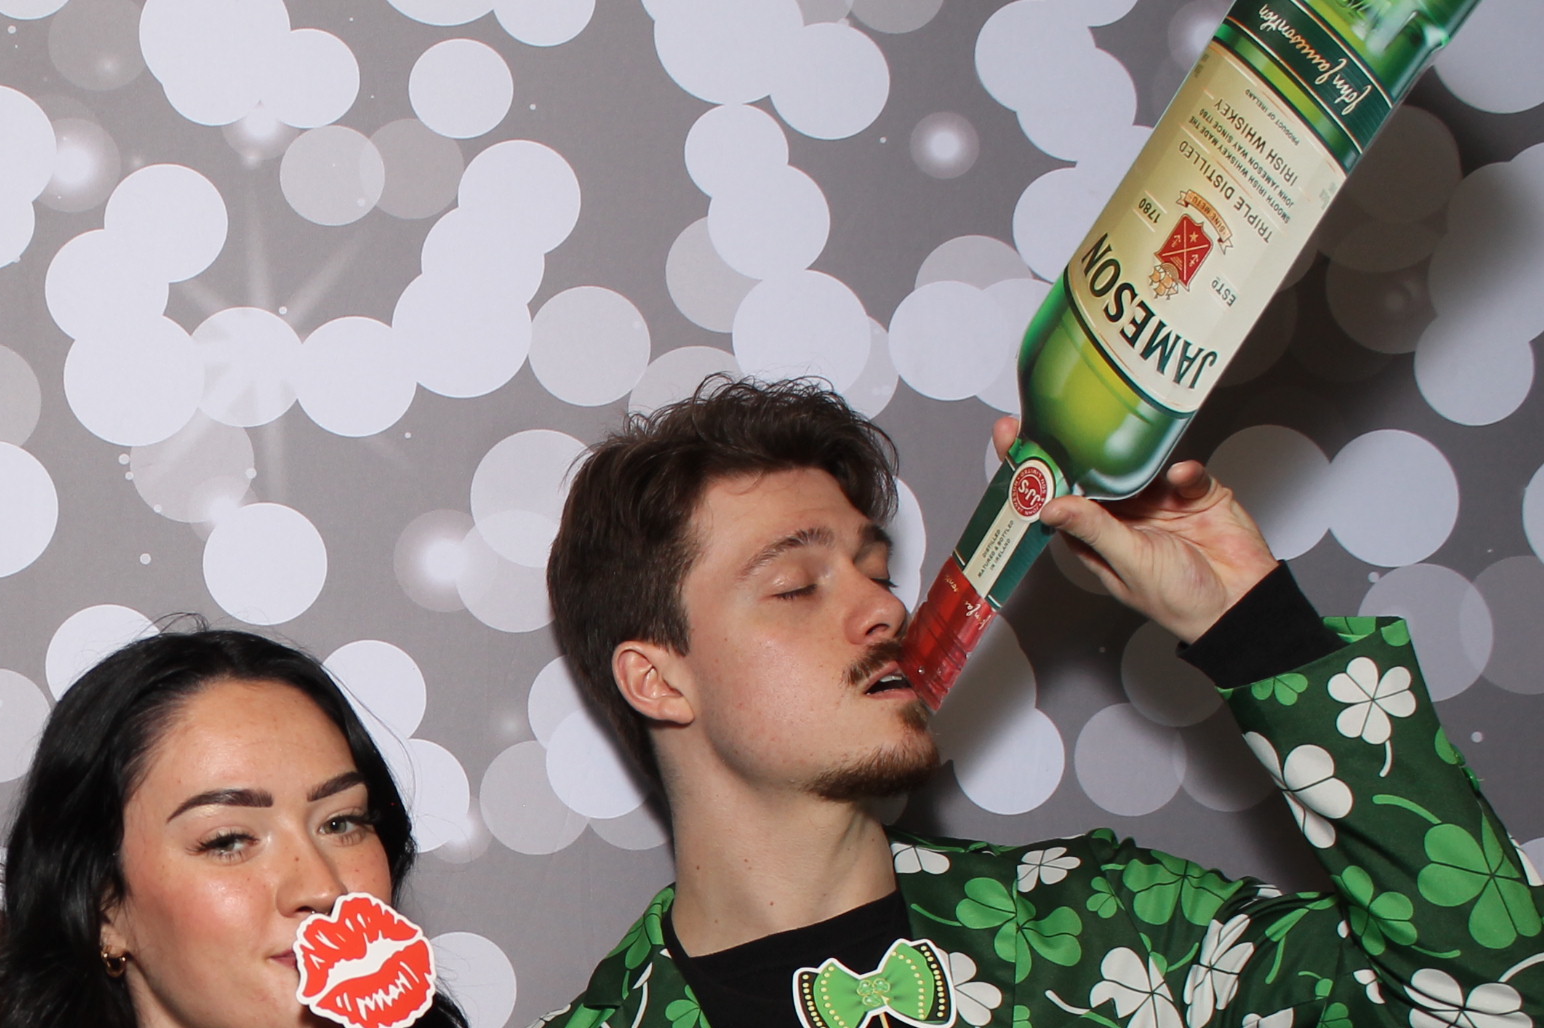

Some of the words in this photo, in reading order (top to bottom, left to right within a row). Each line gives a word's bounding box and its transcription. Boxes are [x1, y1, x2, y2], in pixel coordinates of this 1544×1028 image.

[1245, 88, 1268, 112] IRELAND
[1332, 73, 1372, 116] John
[1187, 115, 1202, 130] THE
[1199, 107, 1213, 122] 1780
[1215, 98, 1266, 150] WHISKEY
[1266, 110, 1276, 120] OF
[1197, 125, 1219, 147] MADE
[1211, 120, 1234, 143] SINCE
[1273, 117, 1300, 146] PRODUCT
[1215, 143, 1249, 178] WHISKEY
[1229, 140, 1249, 159] WAY
[1178, 140, 1235, 199] DISTILLED
[1246, 156, 1279, 192] JAMESON
[1265, 148, 1297, 185] IRISH
[1246, 175, 1267, 198] IRISH
[1276, 188, 1294, 209] JOHN
[1137, 198, 1161, 223] 1780
[1233, 195, 1274, 243] TRIPLE
[1264, 194, 1291, 224] SMOOTH
[1081, 232, 1218, 389] JAMESON
[976, 549, 996, 578] MATURED
[996, 519, 1015, 546] BOTTLED
[980, 528, 1002, 558] DISTILLED
[992, 537, 1011, 563] IRELAND
